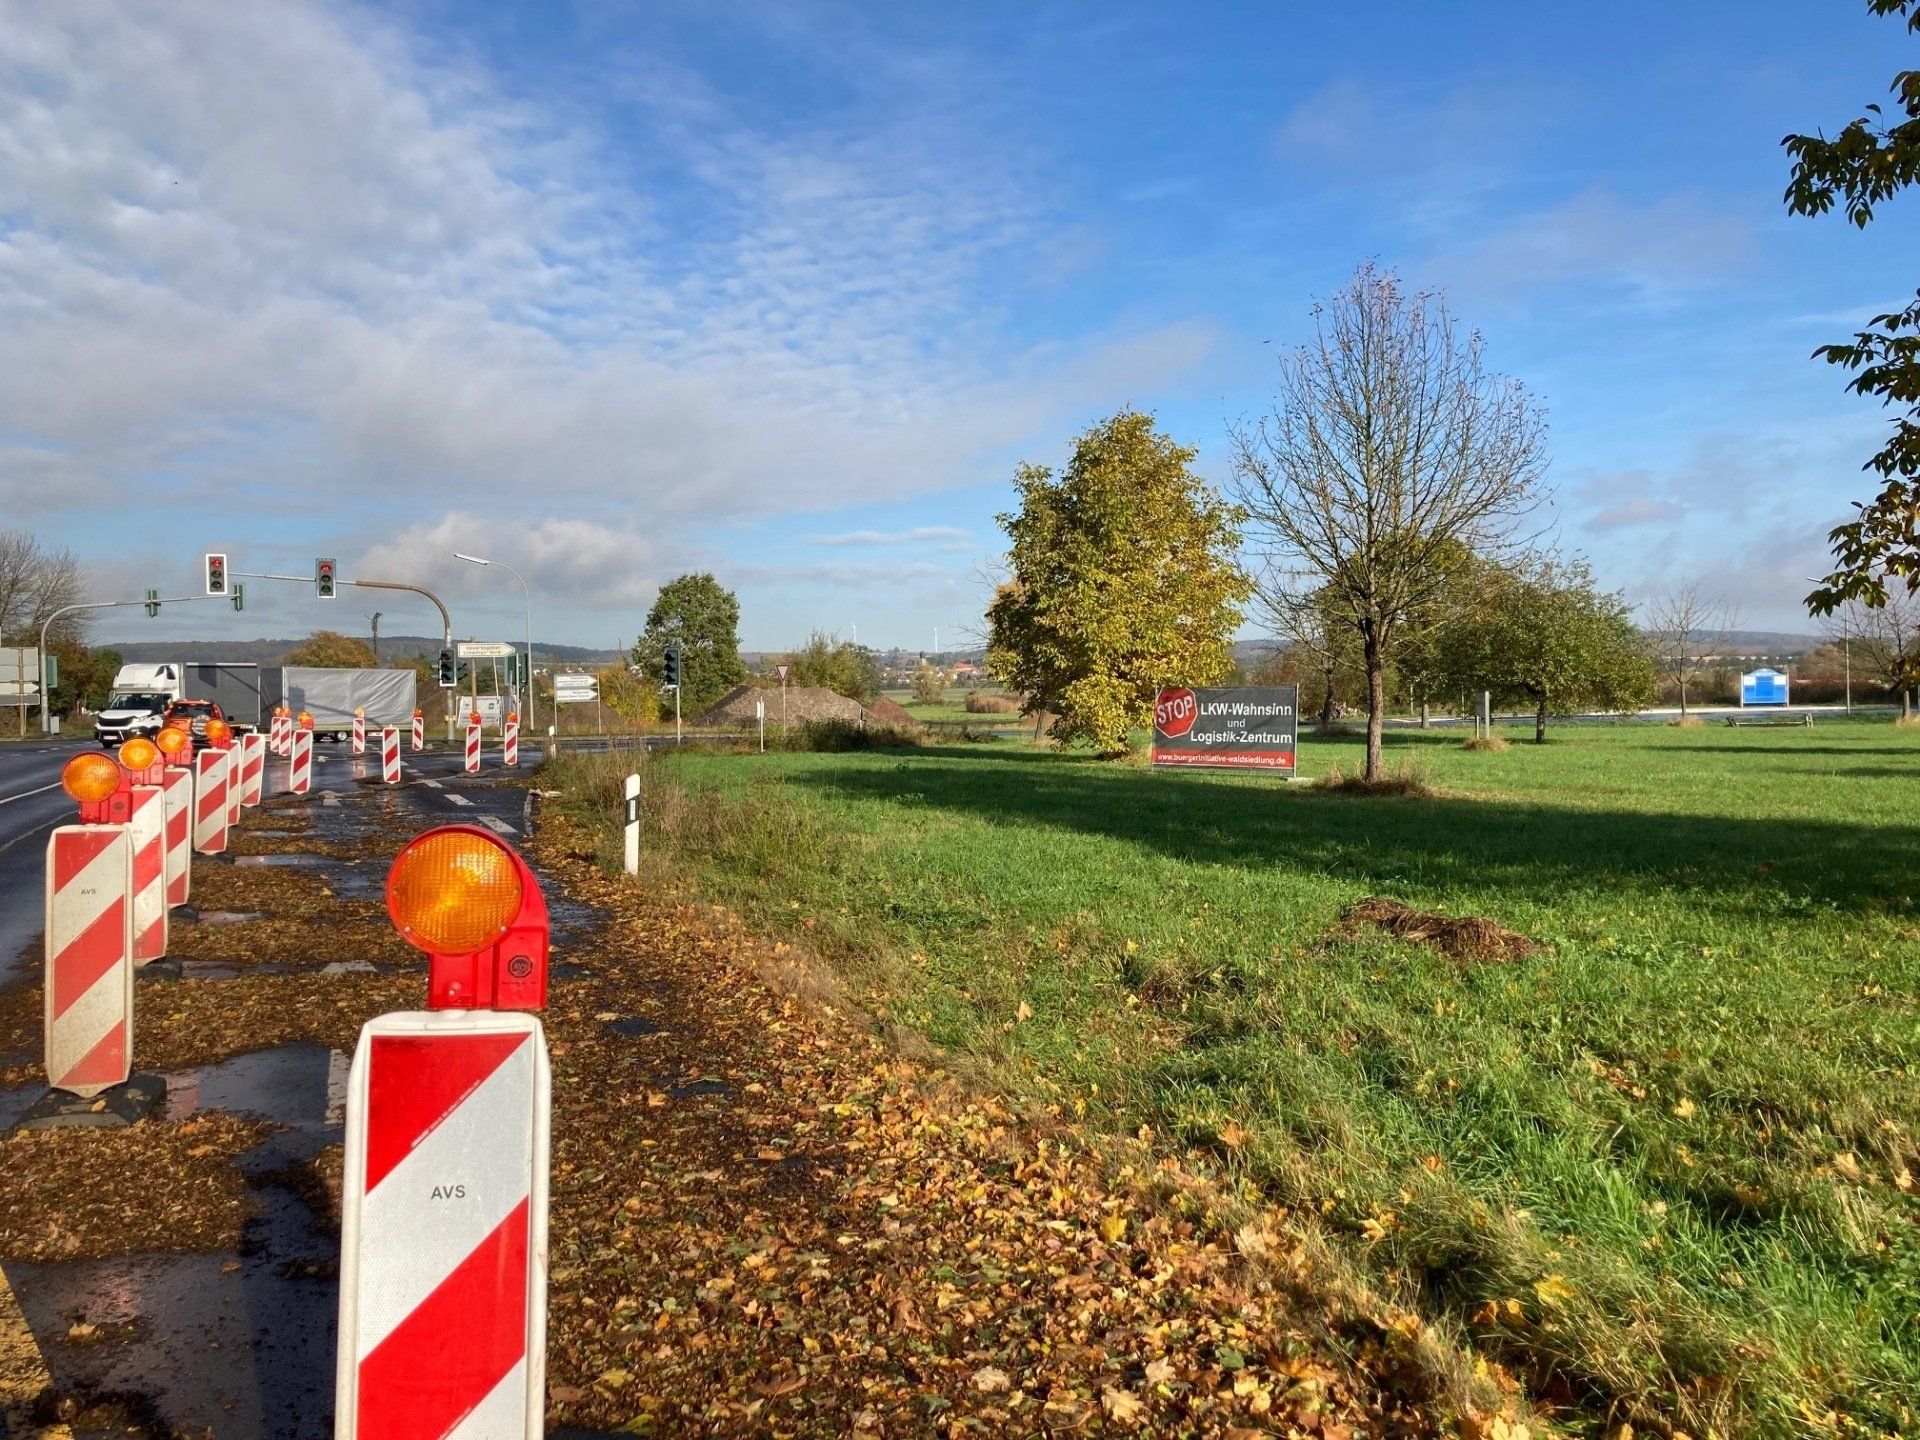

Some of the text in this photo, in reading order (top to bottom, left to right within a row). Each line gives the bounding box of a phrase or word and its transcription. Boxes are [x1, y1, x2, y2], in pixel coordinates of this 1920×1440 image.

[1157, 695, 1193, 724] STOP
[1200, 703, 1292, 716] LKW-Wahnsinn
[1227, 718, 1246, 728] und
[1190, 730, 1293, 745] Logistik-Zentrum
[430, 1185, 466, 1200] AVS
